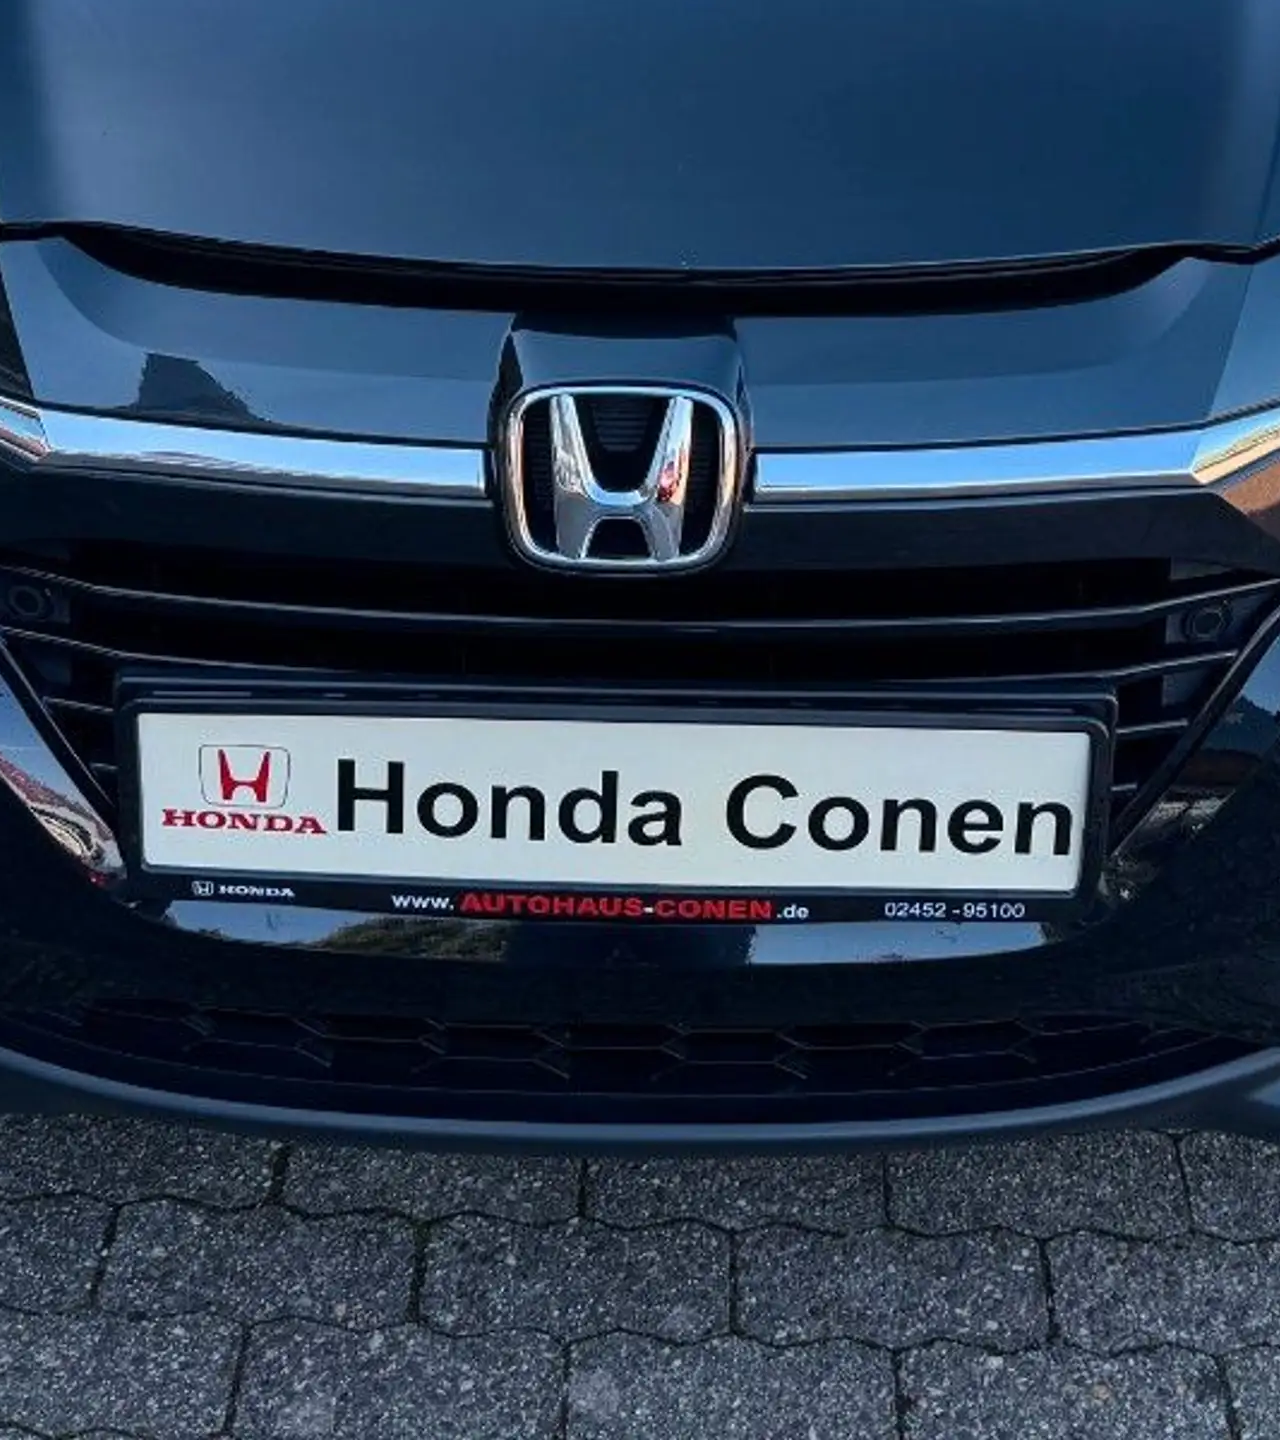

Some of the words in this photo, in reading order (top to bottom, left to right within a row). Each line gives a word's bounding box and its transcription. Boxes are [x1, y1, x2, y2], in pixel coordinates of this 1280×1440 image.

[336, 758, 683, 847] Honda
[725, 773, 1074, 857] Conen
[162, 808, 327, 835] HONDA
[219, 884, 296, 897] HONDA
